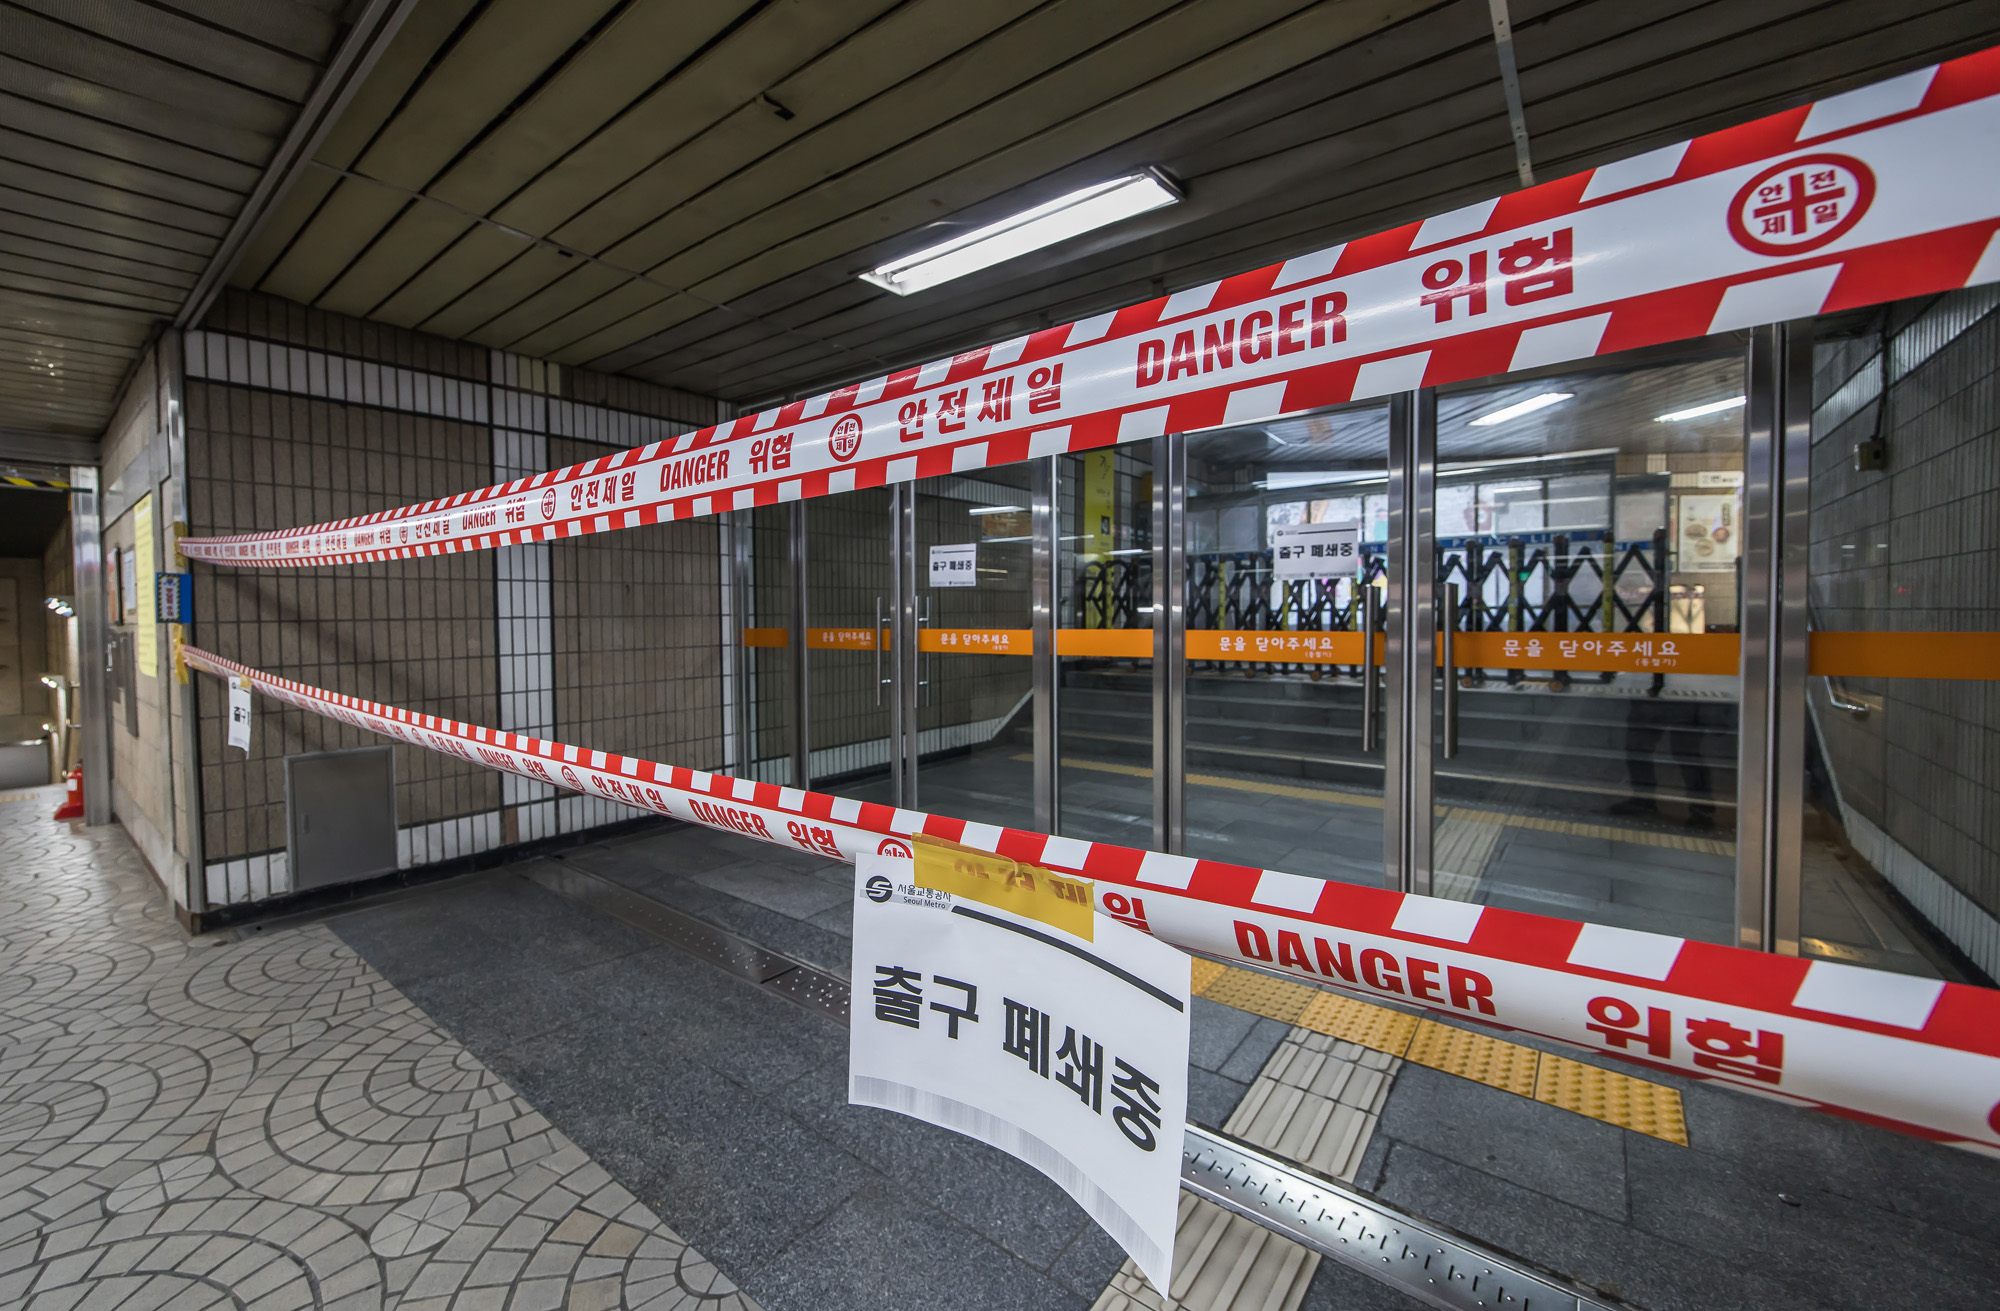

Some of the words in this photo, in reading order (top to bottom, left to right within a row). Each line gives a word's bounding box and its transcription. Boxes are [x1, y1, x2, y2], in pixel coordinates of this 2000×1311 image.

[462, 503, 497, 531] DANGER
[505, 496, 527, 524] 위험
[570, 470, 637, 512] 안전제일
[660, 449, 731, 493] DANGER
[748, 432, 793, 475] 위험
[898, 362, 1065, 444] 안전제일
[1135, 290, 1349, 389] DANGER
[1420, 226, 1576, 325] 위험
[1279, 545, 1305, 560] 출구
[1310, 542, 1353, 558] 폐쇄중
[940, 632, 957, 645] 문을
[962, 633, 1010, 646] 닫아주세요
[1219, 636, 1247, 652] 문을
[1255, 636, 1334, 652] 닫아주세요
[1502, 638, 1544, 657] 문을
[1559, 639, 1680, 658] 닫아주세요
[897, 883, 952, 903] 서울교통공사
[903, 896, 923, 906] Seoul
[924, 899, 946, 909] Metro
[476, 746, 522, 773] DANGER
[522, 757, 554, 783] 위험
[591, 774, 672, 814] 안전제일
[687, 798, 776, 841] DANGER
[786, 820, 846, 859] 위험
[1232, 919, 1498, 1017] DANGER
[1585, 995, 1785, 1087] 위험
[872, 965, 980, 1041] 출구
[1002, 996, 1163, 1153] 폐쇄중
